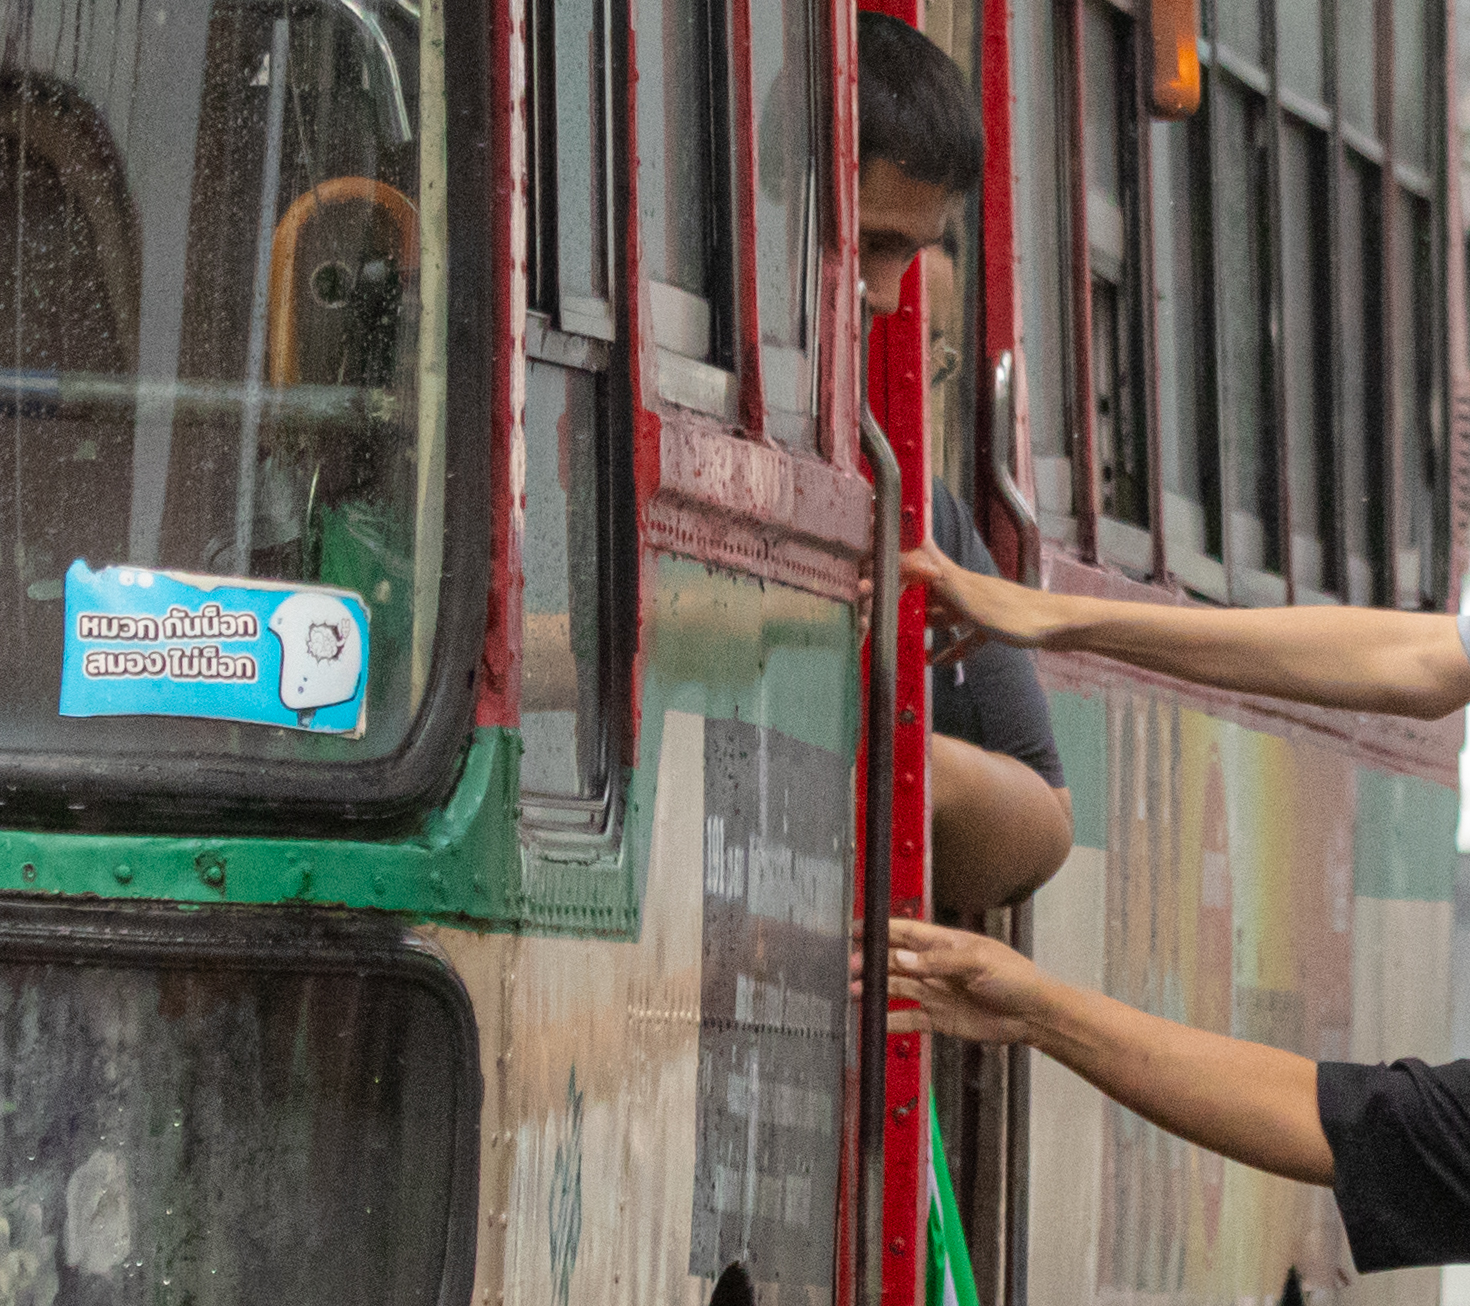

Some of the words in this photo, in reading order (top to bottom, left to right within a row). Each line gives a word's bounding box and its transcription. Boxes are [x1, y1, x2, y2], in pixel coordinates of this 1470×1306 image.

[79, 612, 158, 641] หมวก
[163, 604, 257, 641] กันน็อก
[85, 647, 165, 679] สมอง
[169, 647, 257, 682] ไม่น็อก
